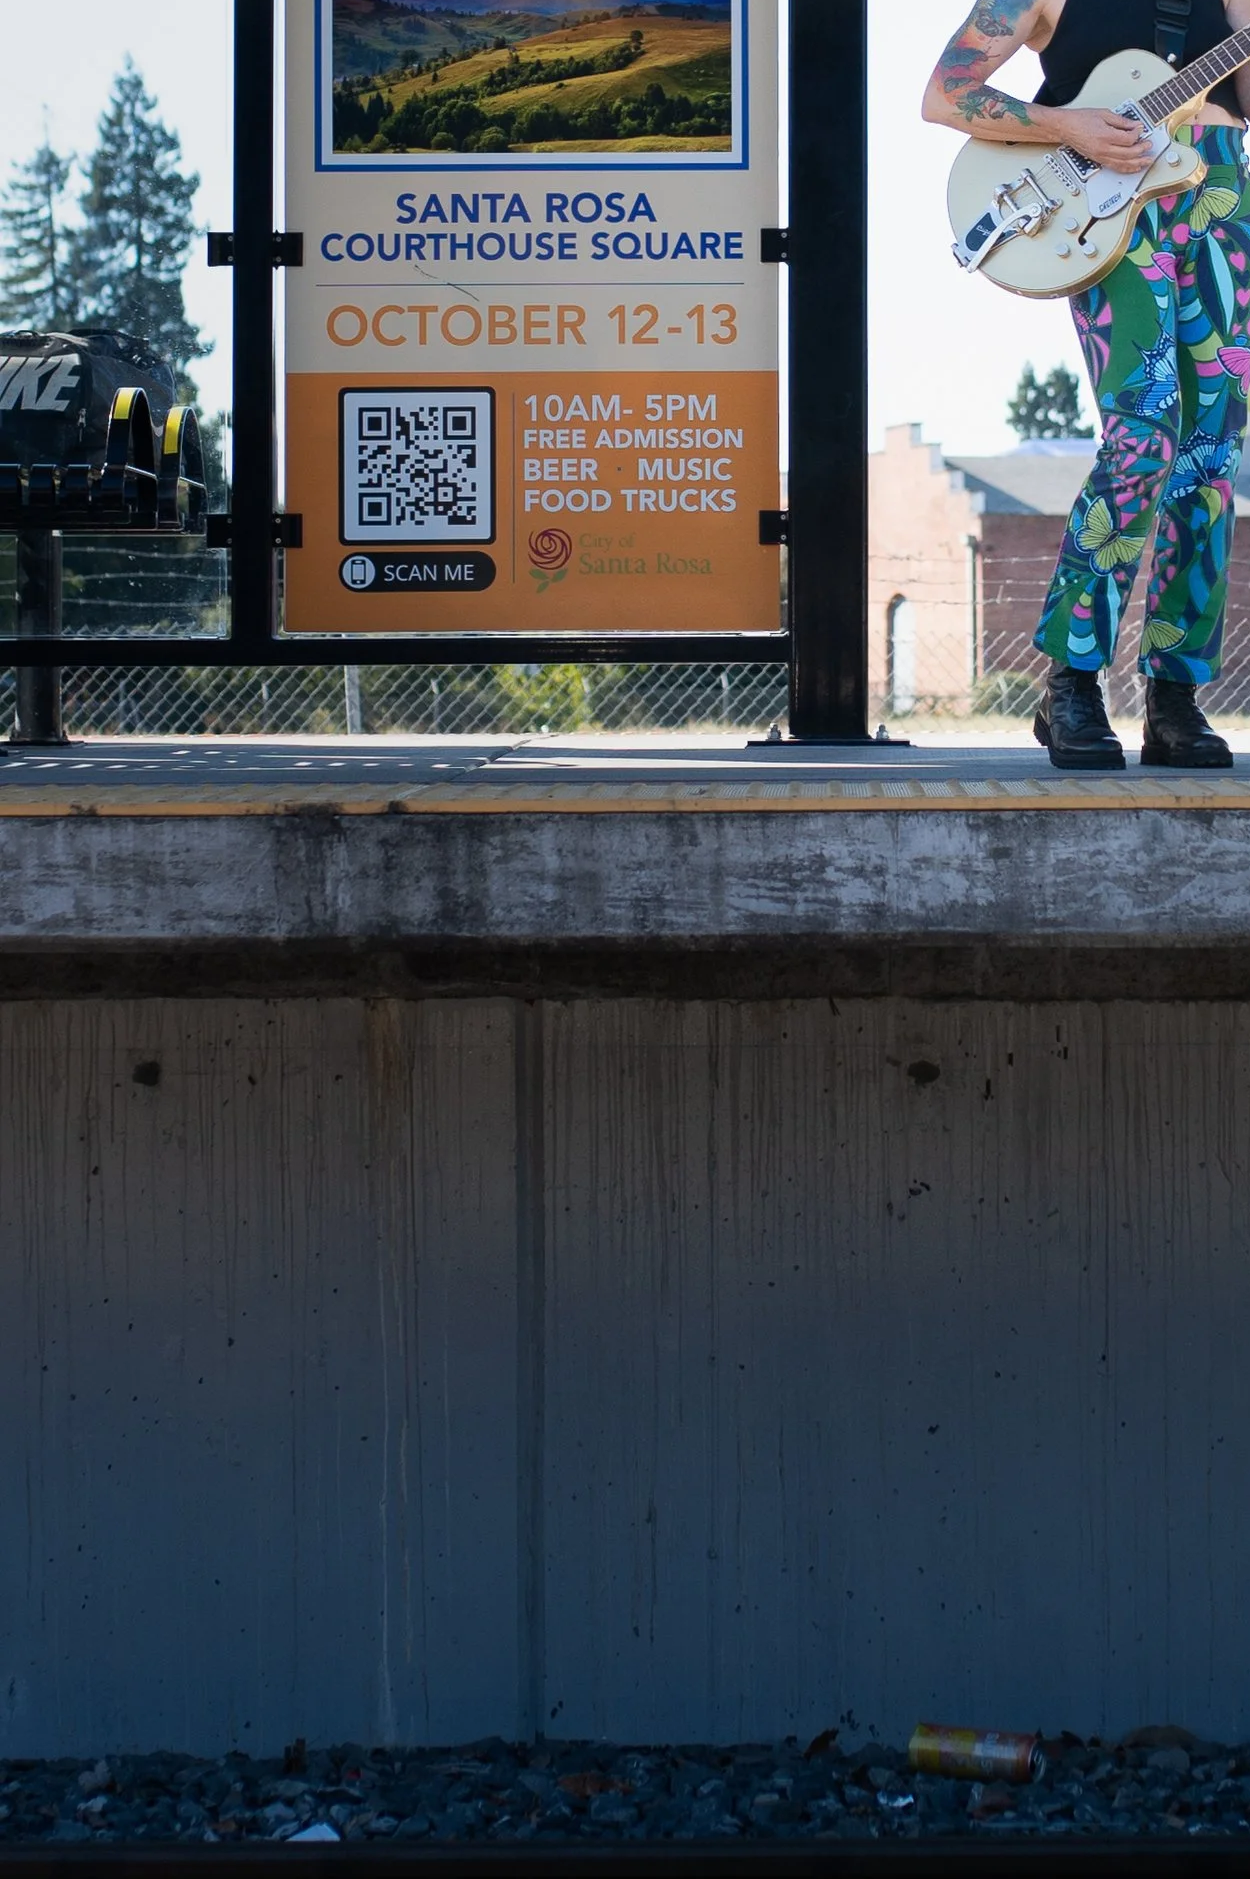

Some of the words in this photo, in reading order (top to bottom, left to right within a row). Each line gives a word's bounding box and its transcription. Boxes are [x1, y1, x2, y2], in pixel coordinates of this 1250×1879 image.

[396, 192, 532, 224] SANTA
[545, 192, 657, 223] ROSA
[320, 231, 578, 262] COURTHOUSE
[591, 230, 744, 261] SQUARE
[326, 303, 587, 347] OCTOBER
[0, 353, 81, 412] IKE
[644, 394, 717, 421] 5PM
[523, 429, 586, 449] FREE
[594, 428, 744, 449] ADMISSION
[523, 458, 598, 481] BEER
[638, 458, 733, 481] MUSIC
[524, 489, 612, 512] FOOD
[621, 488, 737, 512] TRUCKS
[579, 533, 613, 553] City
[619, 531, 635, 548] of
[384, 563, 440, 582] SCAN
[444, 563, 475, 581] ME
[579, 552, 647, 575] Santa
[656, 552, 713, 574] Rosa
